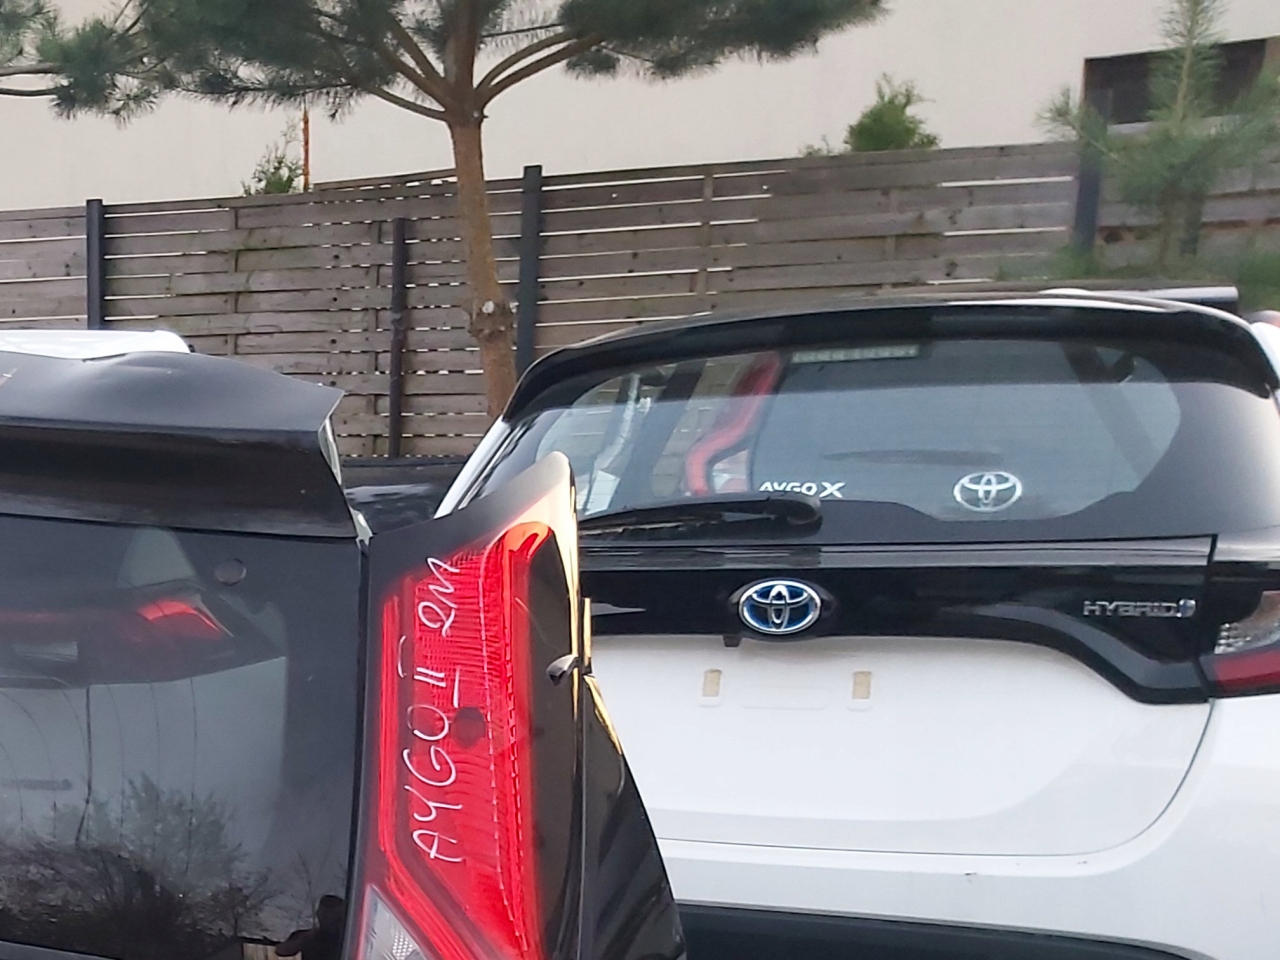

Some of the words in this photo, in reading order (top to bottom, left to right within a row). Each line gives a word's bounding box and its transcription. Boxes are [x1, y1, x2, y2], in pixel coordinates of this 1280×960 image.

[819, 481, 846, 499] X
[1083, 600, 1179, 617] HYBRID
[402, 703, 465, 863] AYGO
